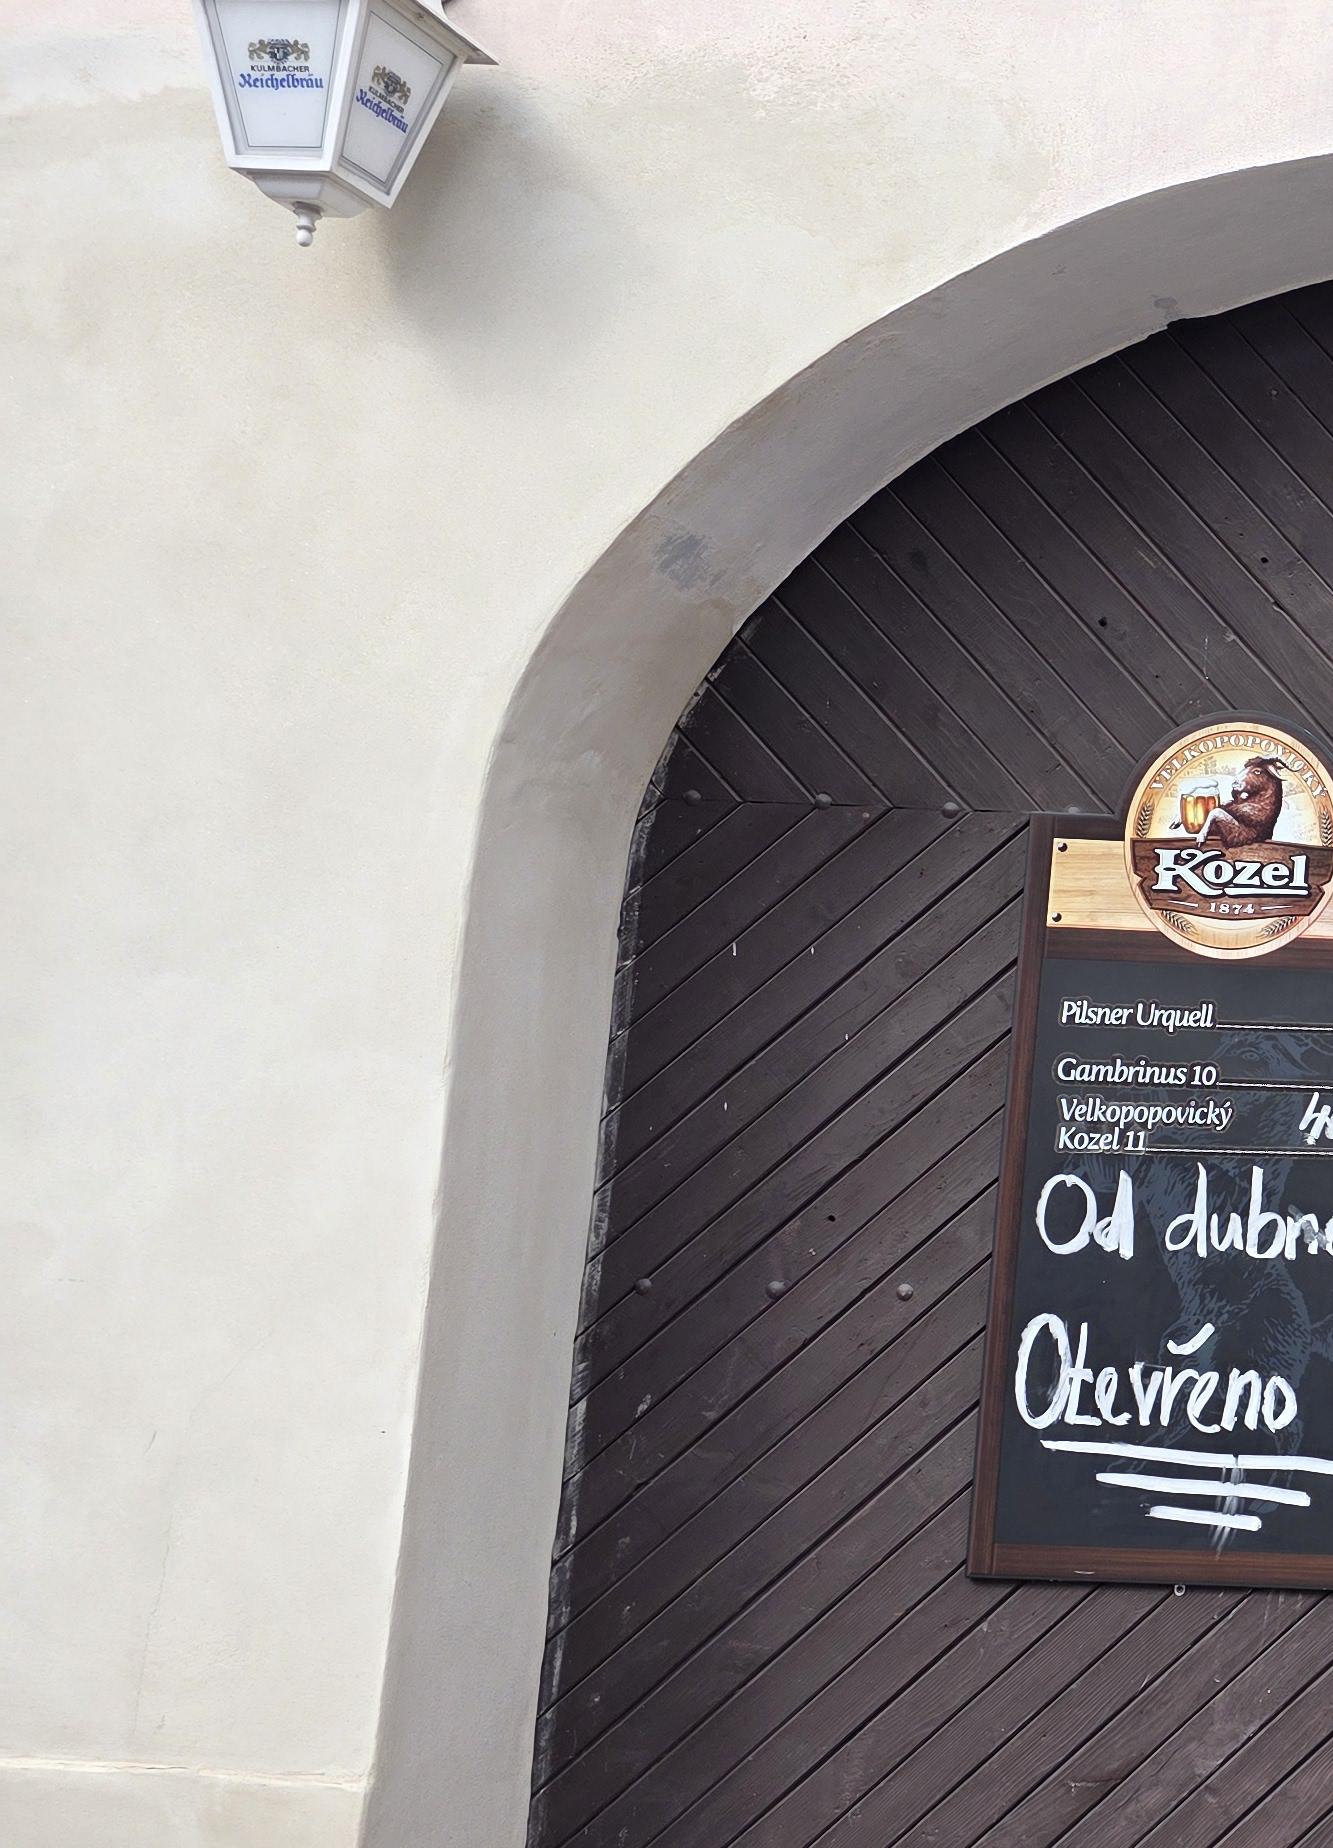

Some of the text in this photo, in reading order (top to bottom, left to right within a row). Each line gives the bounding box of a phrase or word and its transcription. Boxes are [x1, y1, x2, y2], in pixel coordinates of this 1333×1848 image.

[238, 73, 324, 91] Reichelbräu
[250, 65, 310, 73] KULMBACHER
[355, 88, 409, 134] Reichelbräu
[1151, 848, 1310, 897] Kozel
[1208, 902, 1255, 915] 1874
[1061, 999, 1134, 1025] Pilsner
[1136, 1002, 1214, 1033] Urquell
[1057, 1057, 1188, 1085] Gambrinus
[1190, 1065, 1217, 1086] 10
[1060, 1097, 1234, 1131] Velkopopovický
[1058, 1126, 1121, 1151] Kozel
[1123, 1130, 1146, 1151] 11
[1036, 1169, 1134, 1261] Od
[1014, 1312, 1298, 1434] Otevřeno
